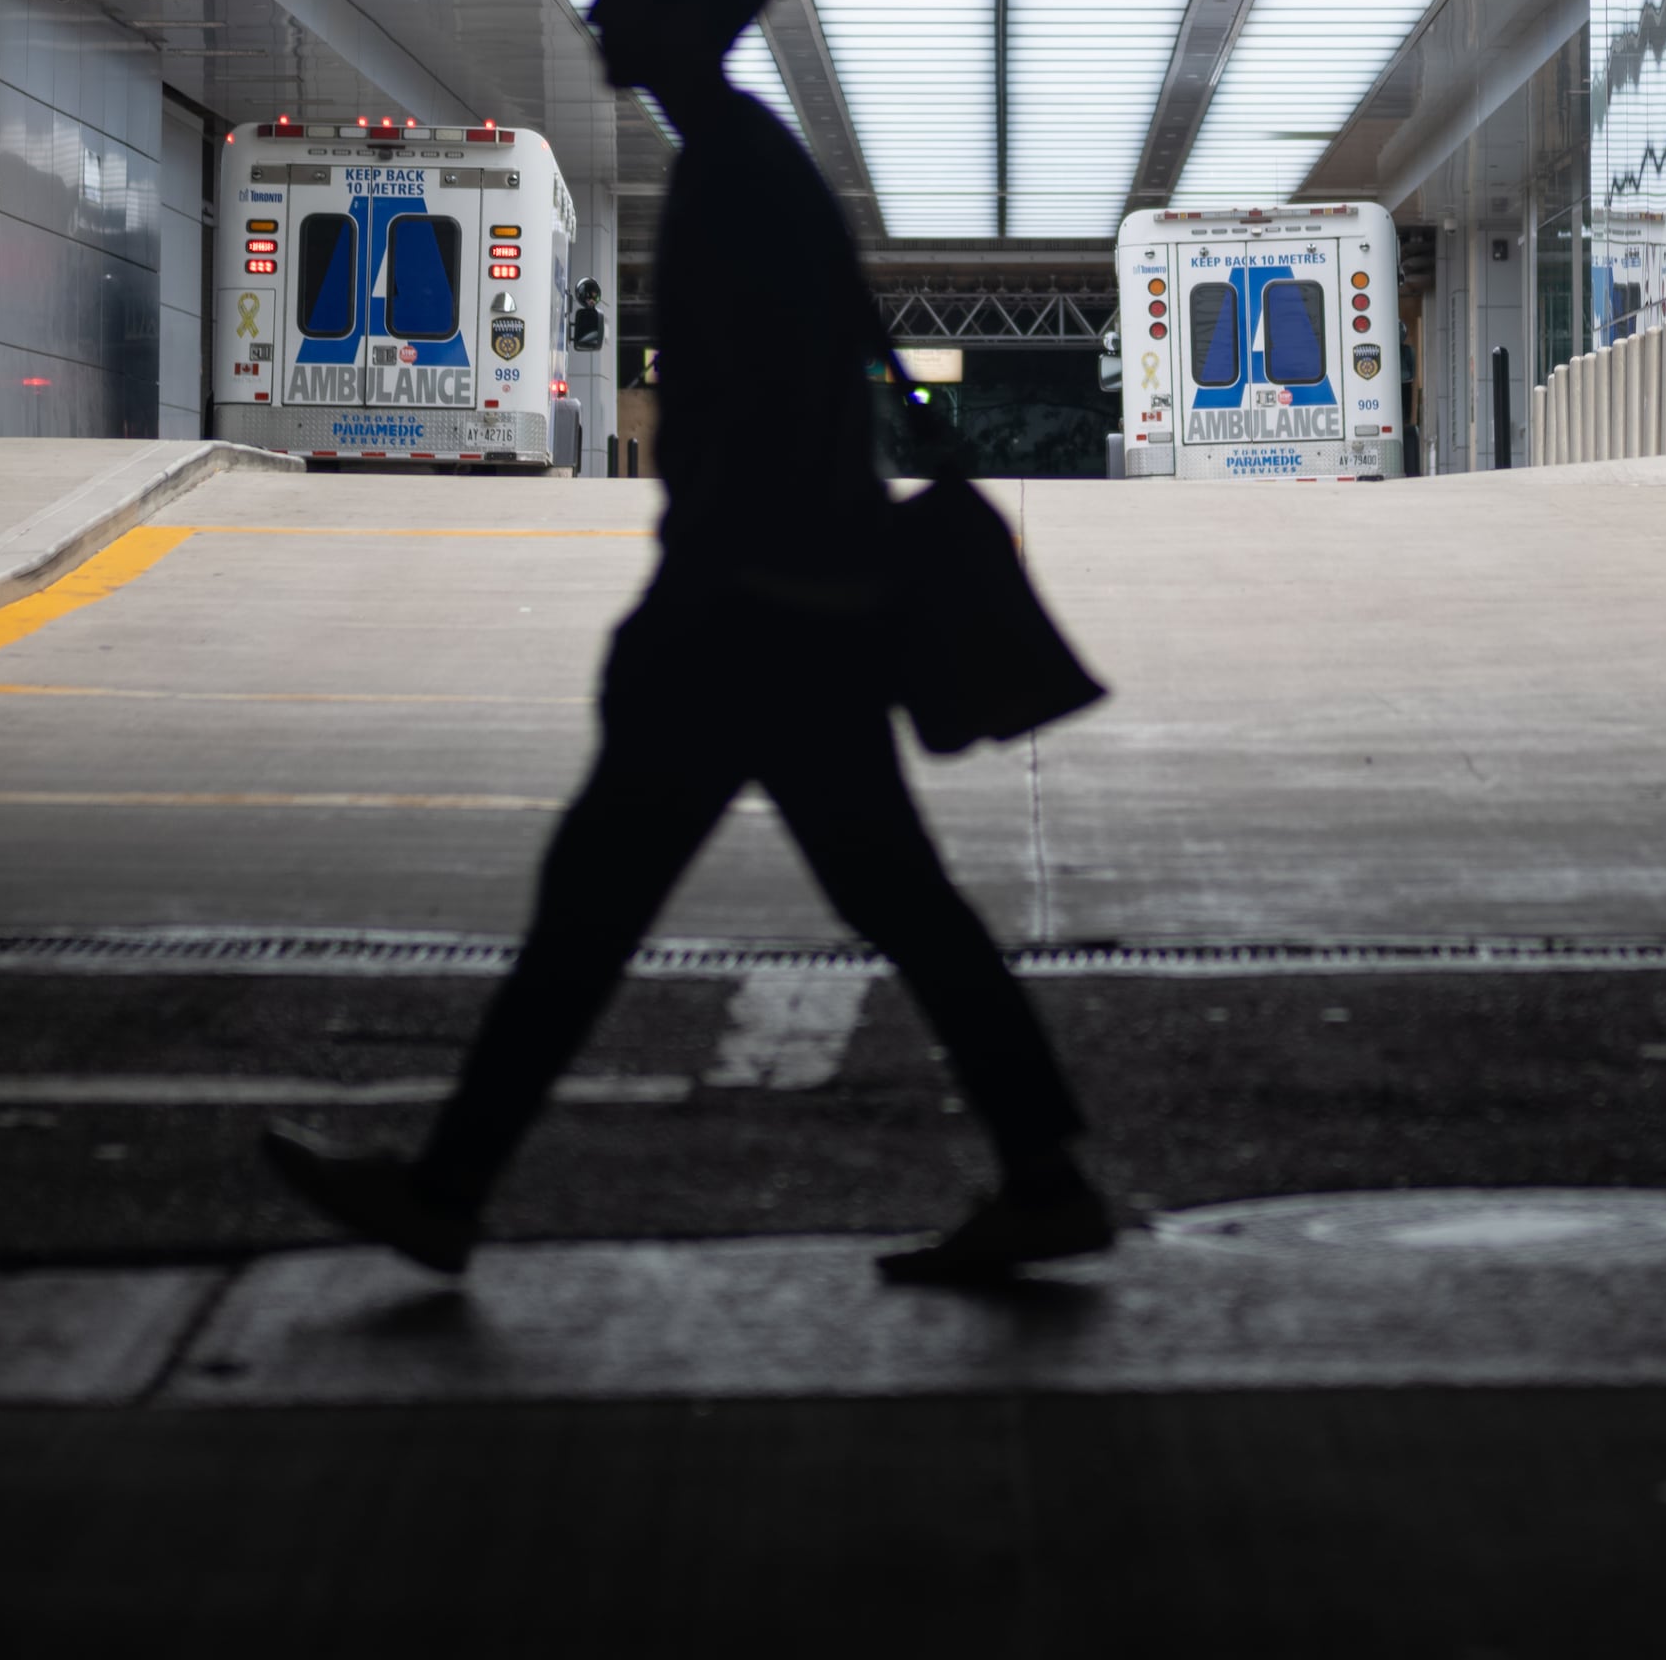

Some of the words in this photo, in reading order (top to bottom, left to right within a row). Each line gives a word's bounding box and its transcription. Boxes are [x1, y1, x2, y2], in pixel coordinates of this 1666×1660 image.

[345, 169, 381, 181] KEEP
[386, 170, 425, 182] BACK
[347, 183, 362, 194] 10
[367, 183, 424, 195] METRES
[250, 191, 283, 203] TORONTO
[1191, 257, 1221, 268] KEEP
[1225, 256, 1260, 267] BACK
[1261, 255, 1275, 266] 10
[1278, 254, 1326, 265] METRES
[495, 368, 520, 381] 989
[287, 365, 471, 404] AMBULANCE
[1358, 399, 1379, 411] 909
[341, 415, 417, 423] TORONTO
[1188, 407, 1340, 441] AMBULANCE
[333, 423, 424, 438] PARAMEDIC
[340, 437, 417, 446] SERVICES
[1233, 448, 1295, 456] TORONTO
[1226, 455, 1302, 468] PARAMEDIC
